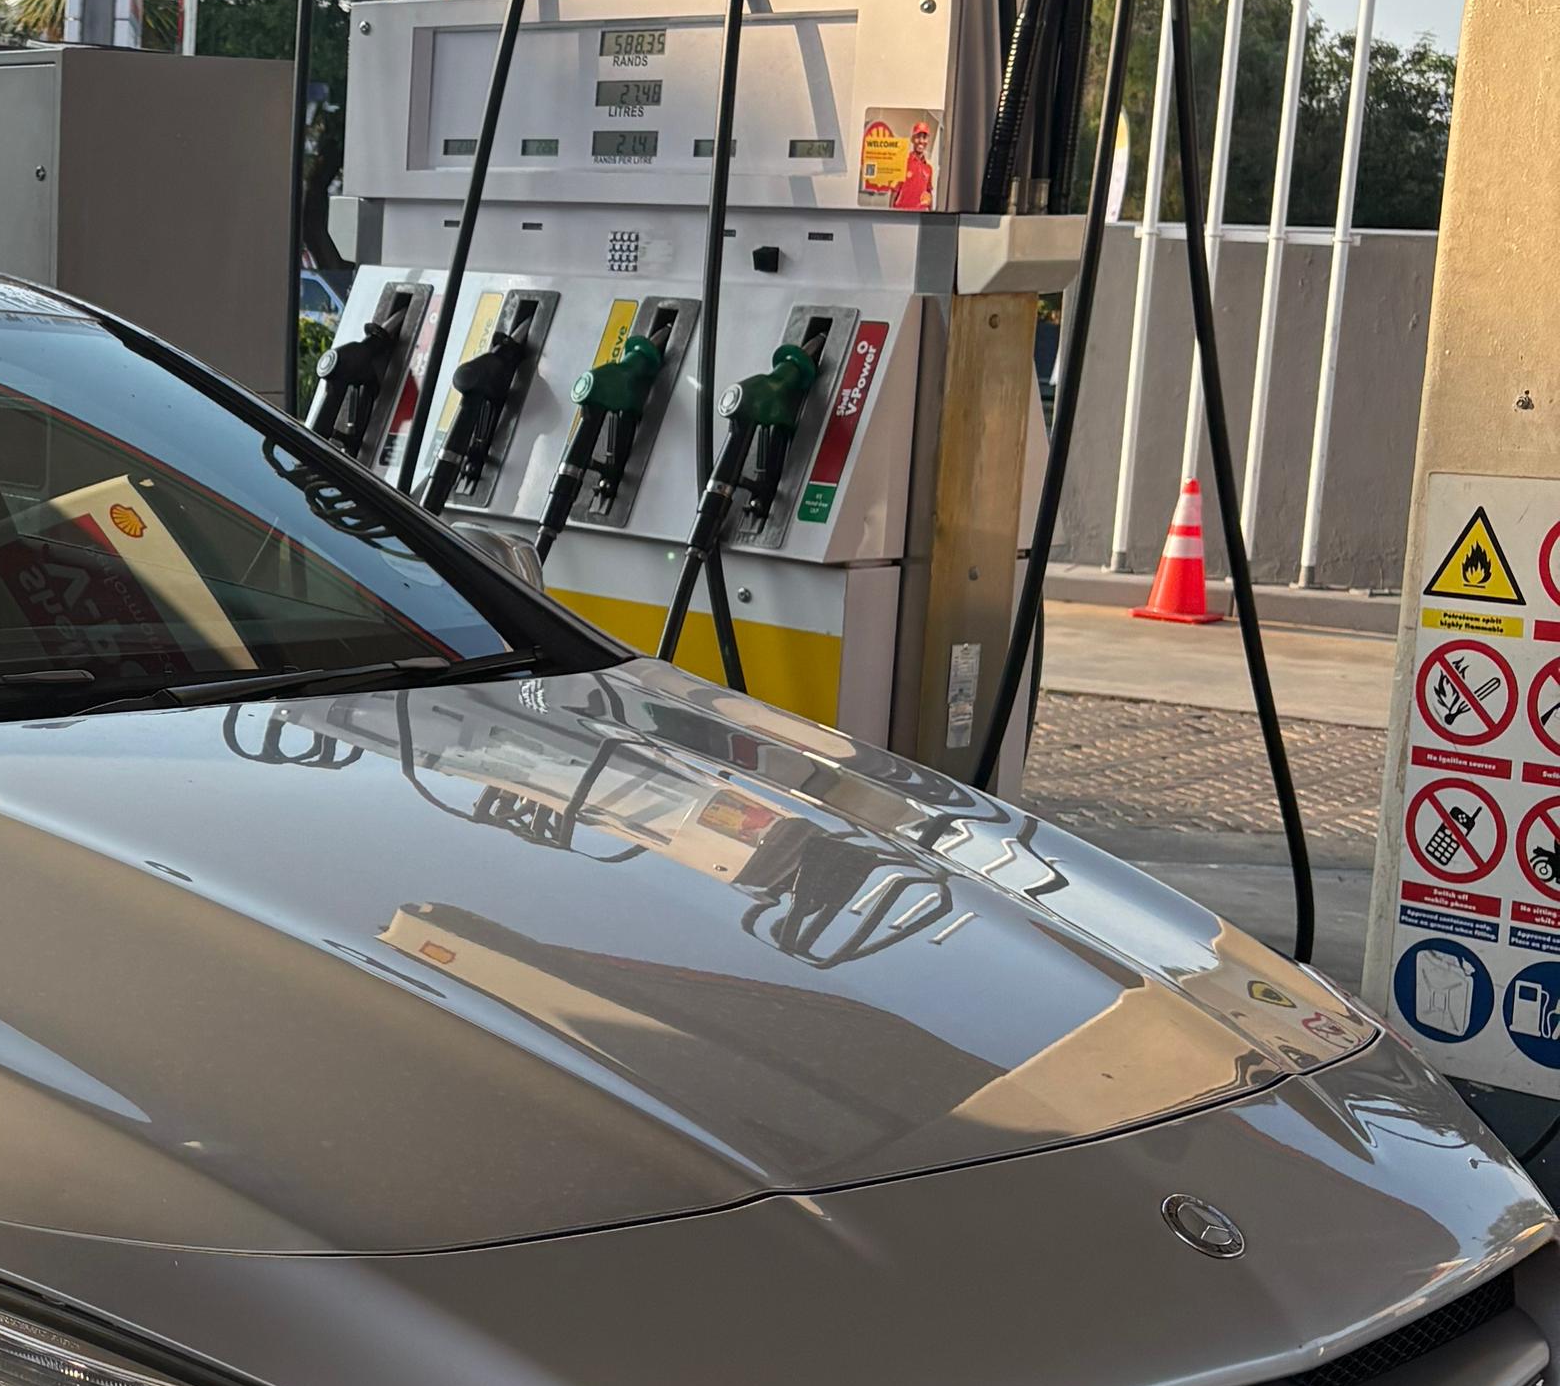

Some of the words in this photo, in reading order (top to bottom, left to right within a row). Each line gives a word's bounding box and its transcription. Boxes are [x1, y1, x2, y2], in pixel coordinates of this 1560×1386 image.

[612, 55, 648, 67] RANDS
[608, 106, 645, 118] LITRES
[845, 344, 877, 416] V-Power
[836, 388, 852, 416] Shell
[1443, 612, 1480, 622] Petroleum
[1482, 616, 1502, 625] spirit
[1440, 620, 1463, 630] highly
[1464, 621, 1504, 633] flammable
[1426, 753, 1438, 762] No
[1439, 754, 1468, 766] ignition
[1469, 760, 1496, 770] sources
[1433, 888, 1456, 899] Switch
[1457, 893, 1469, 901] off
[1424, 895, 1449, 905] mobile
[1449, 900, 1476, 911] phones
